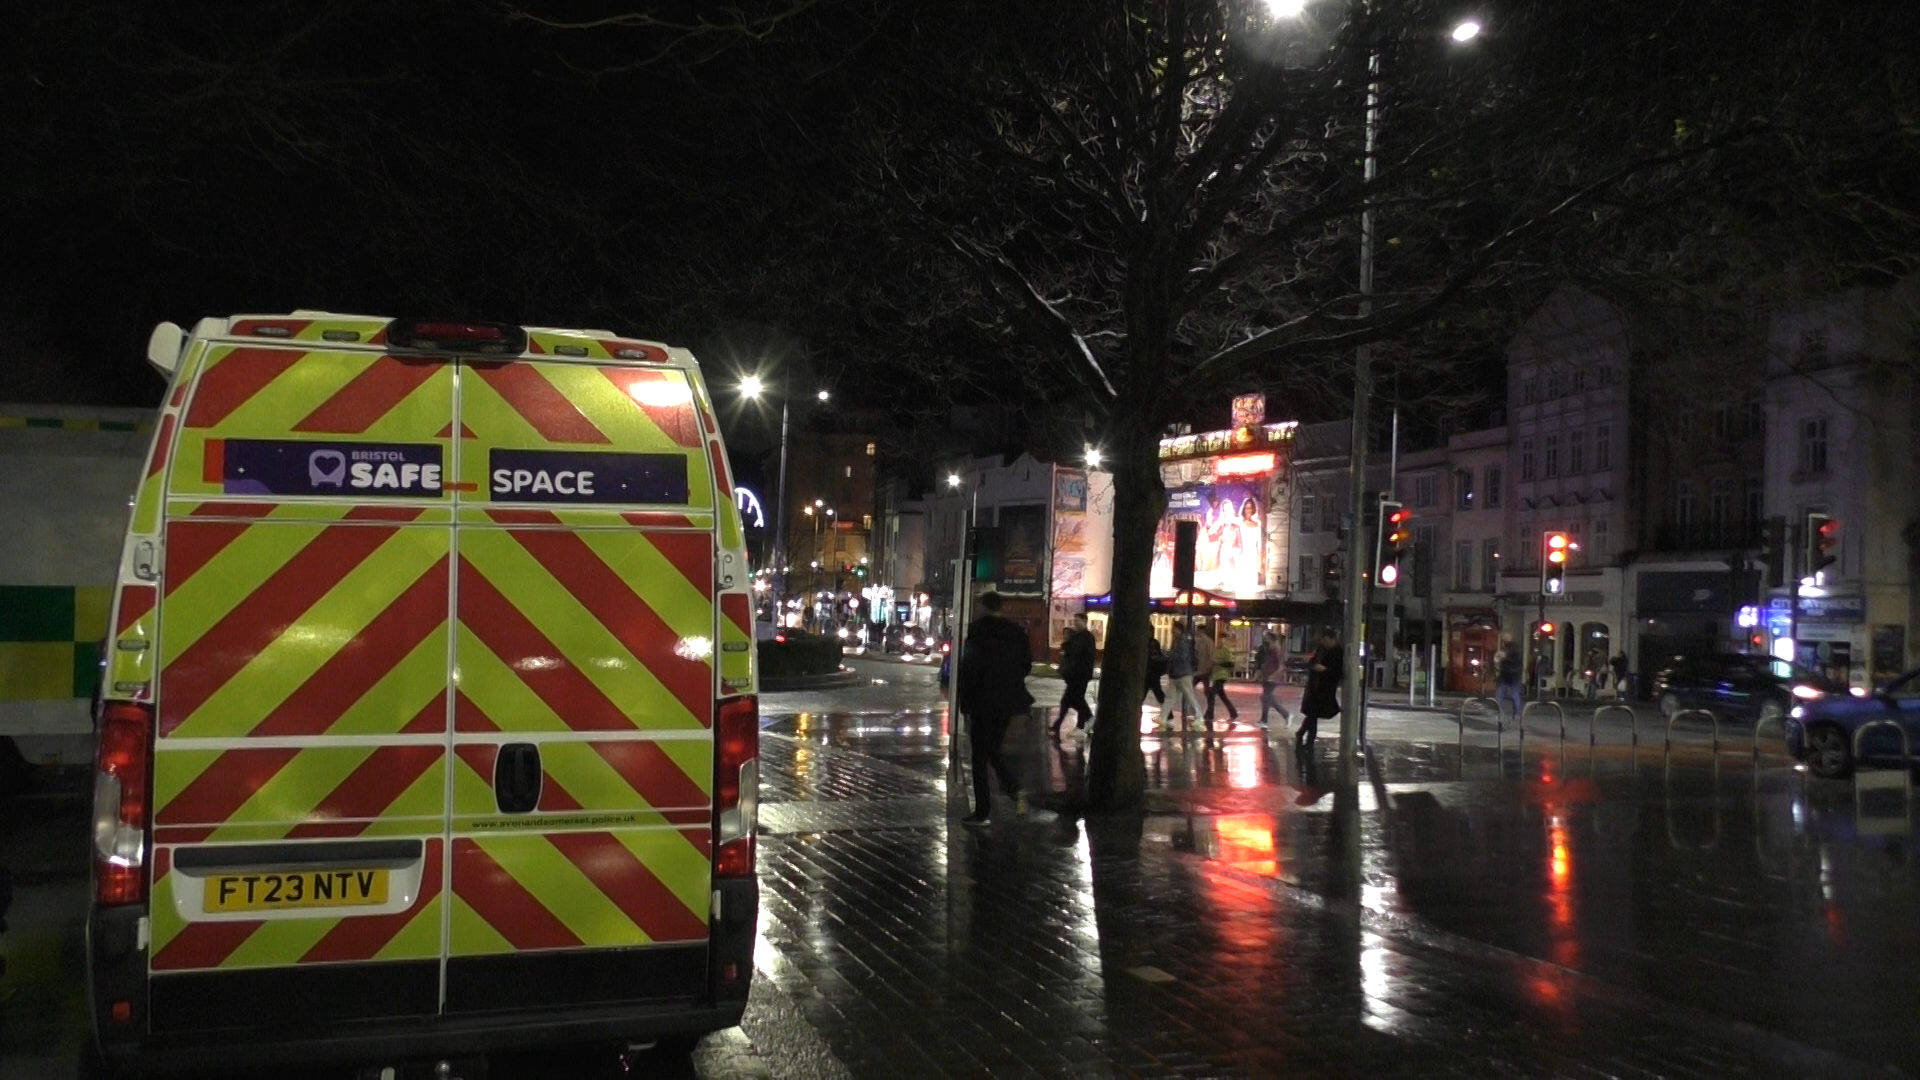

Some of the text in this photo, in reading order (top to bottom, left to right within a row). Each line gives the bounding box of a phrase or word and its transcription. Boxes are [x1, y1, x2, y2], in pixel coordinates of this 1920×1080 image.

[351, 451, 406, 462] BRISTOL
[351, 463, 595, 494] SAFE SPACE
[472, 815, 636, 829] www.avonandsomerset.police.uk
[219, 871, 374, 905] FT23 NTV
